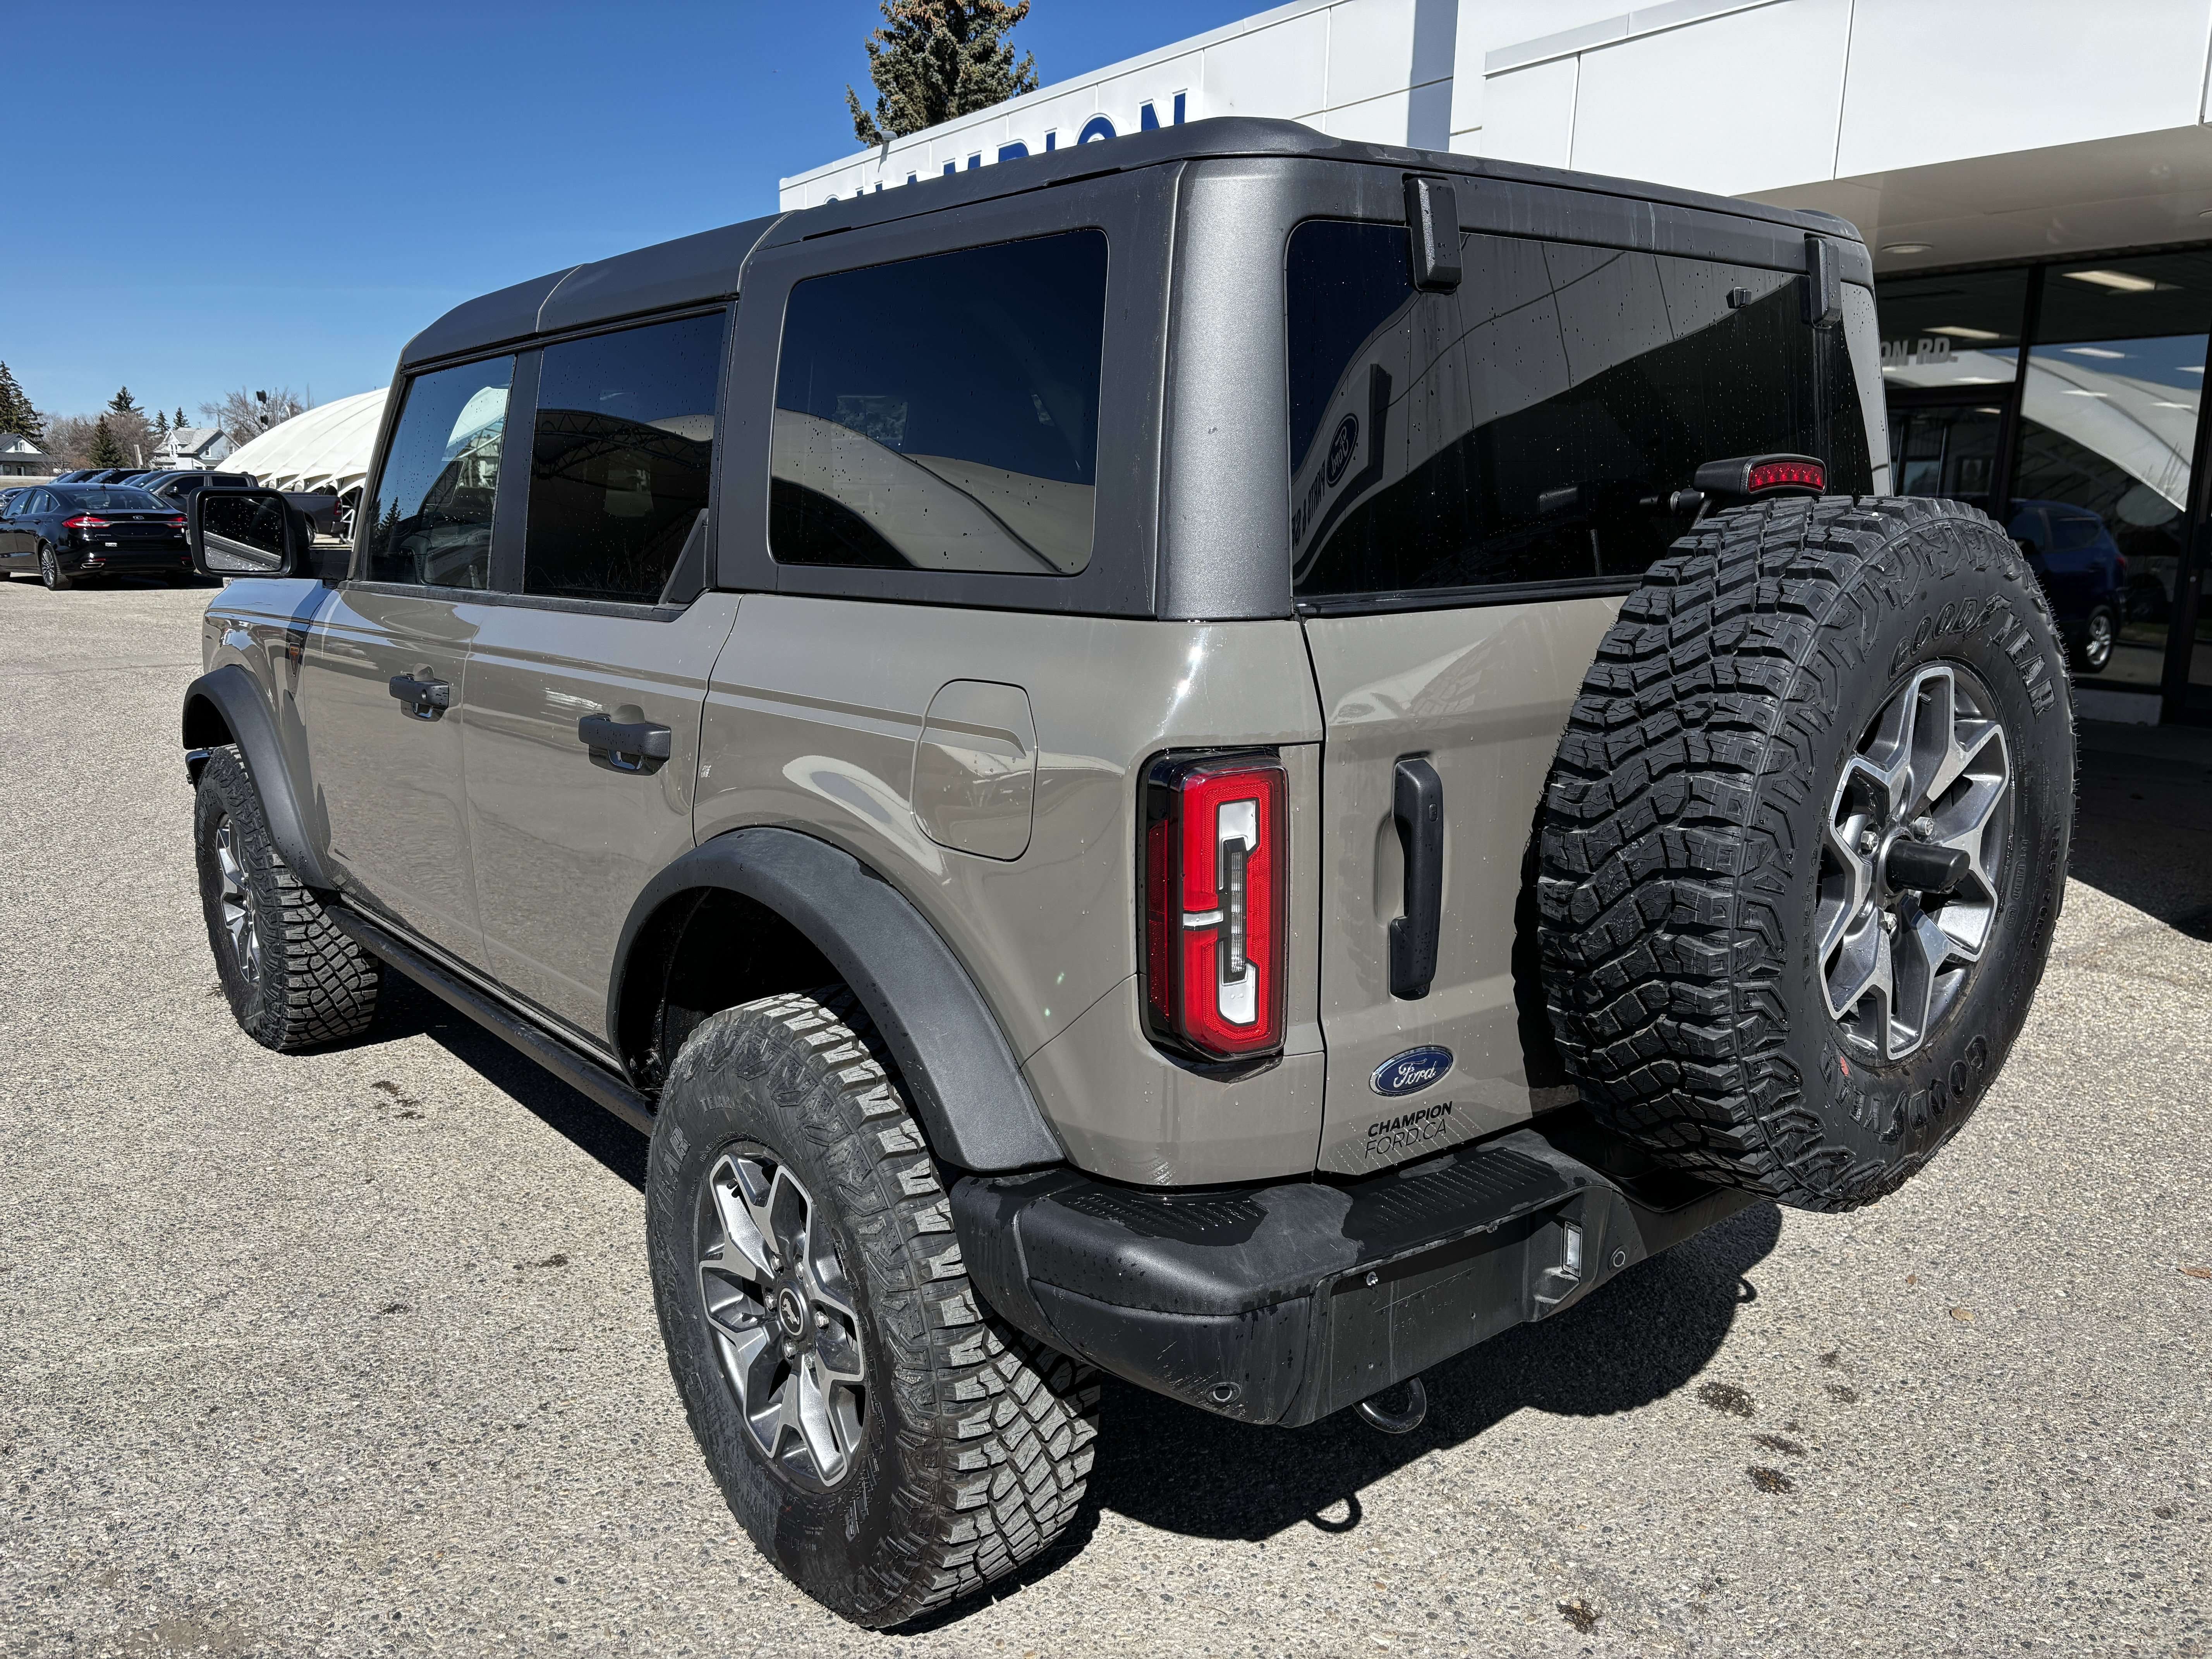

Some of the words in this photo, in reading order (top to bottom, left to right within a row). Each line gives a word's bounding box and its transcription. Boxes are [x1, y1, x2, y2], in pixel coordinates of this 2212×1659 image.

[1917, 338, 1958, 365] RD.
[1888, 592, 2055, 716] GOODYEAR
[1393, 1058, 1437, 1088] Ford
[1368, 1101, 1453, 1137] CHAMPION
[1365, 1119, 1446, 1159] FORD.CA
